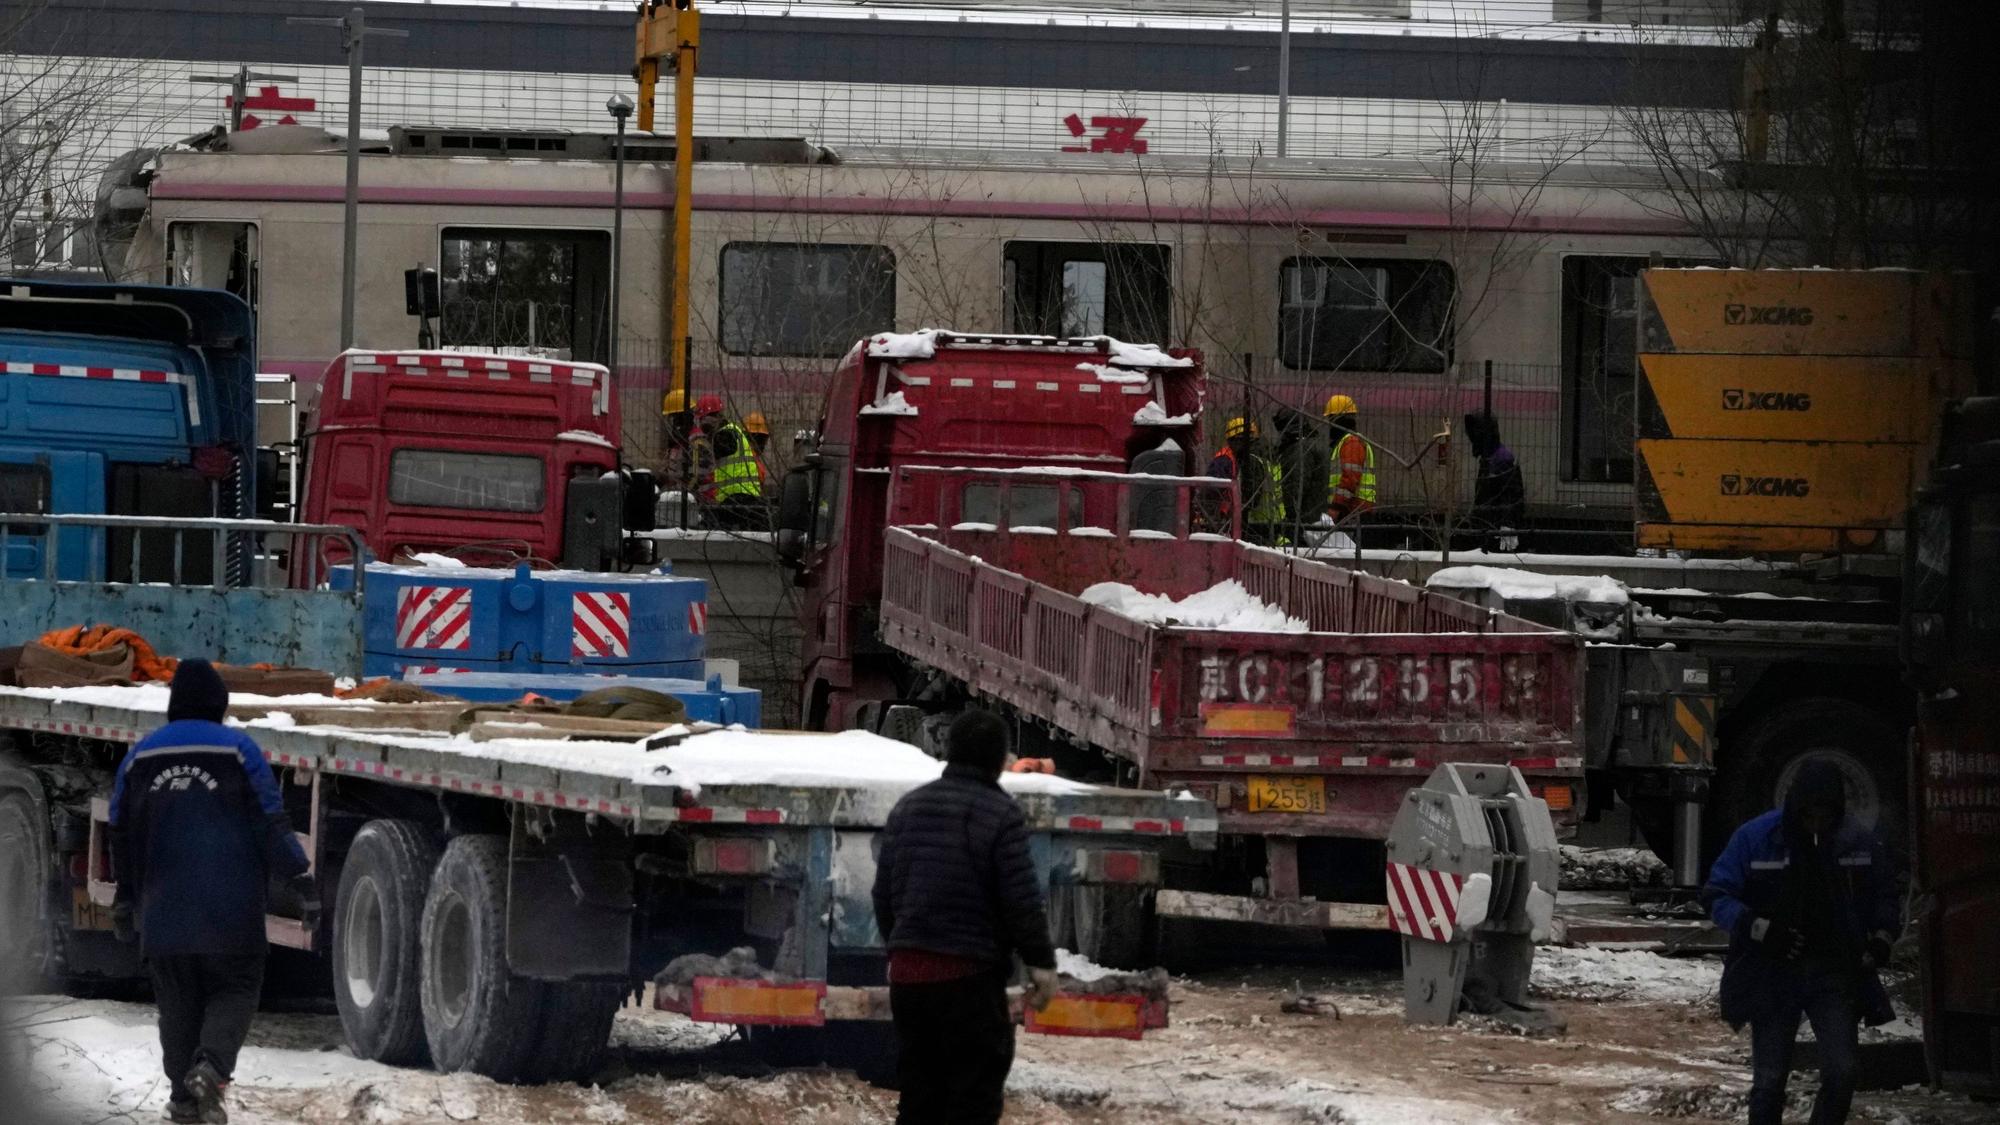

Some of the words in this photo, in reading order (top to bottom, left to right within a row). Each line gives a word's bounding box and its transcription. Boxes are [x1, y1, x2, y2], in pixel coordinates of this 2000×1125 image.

[1750, 306, 1814, 326] XCMG
[1747, 392, 1811, 412] XCMG
[1744, 477, 1809, 497] XCMG
